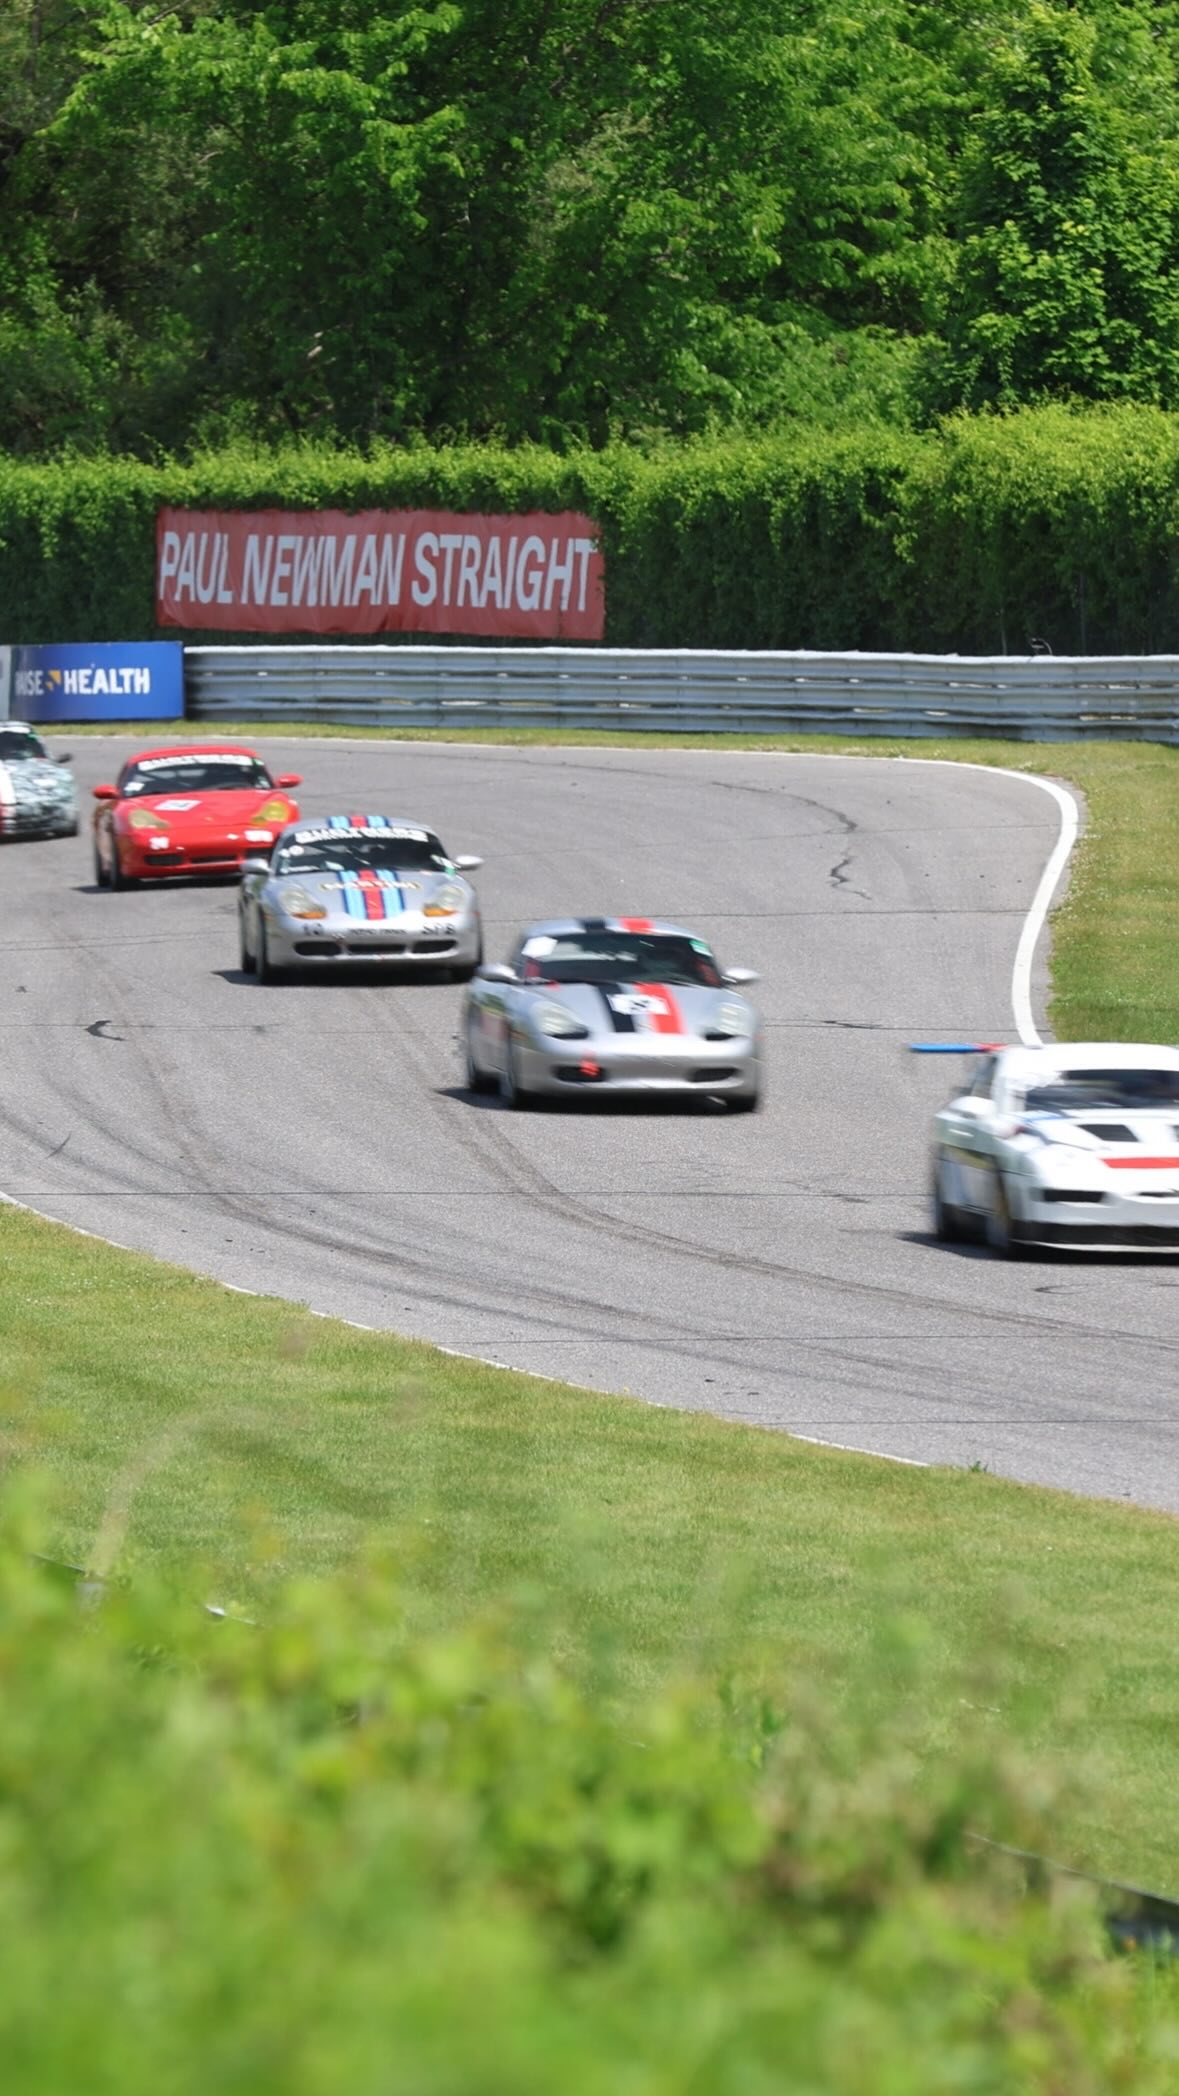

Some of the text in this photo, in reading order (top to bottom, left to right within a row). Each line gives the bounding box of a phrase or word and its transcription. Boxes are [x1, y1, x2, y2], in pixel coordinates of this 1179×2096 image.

[159, 531, 598, 612] PAUL NEWMAN STRAIGHT
[64, 667, 150, 695] HEALTH
